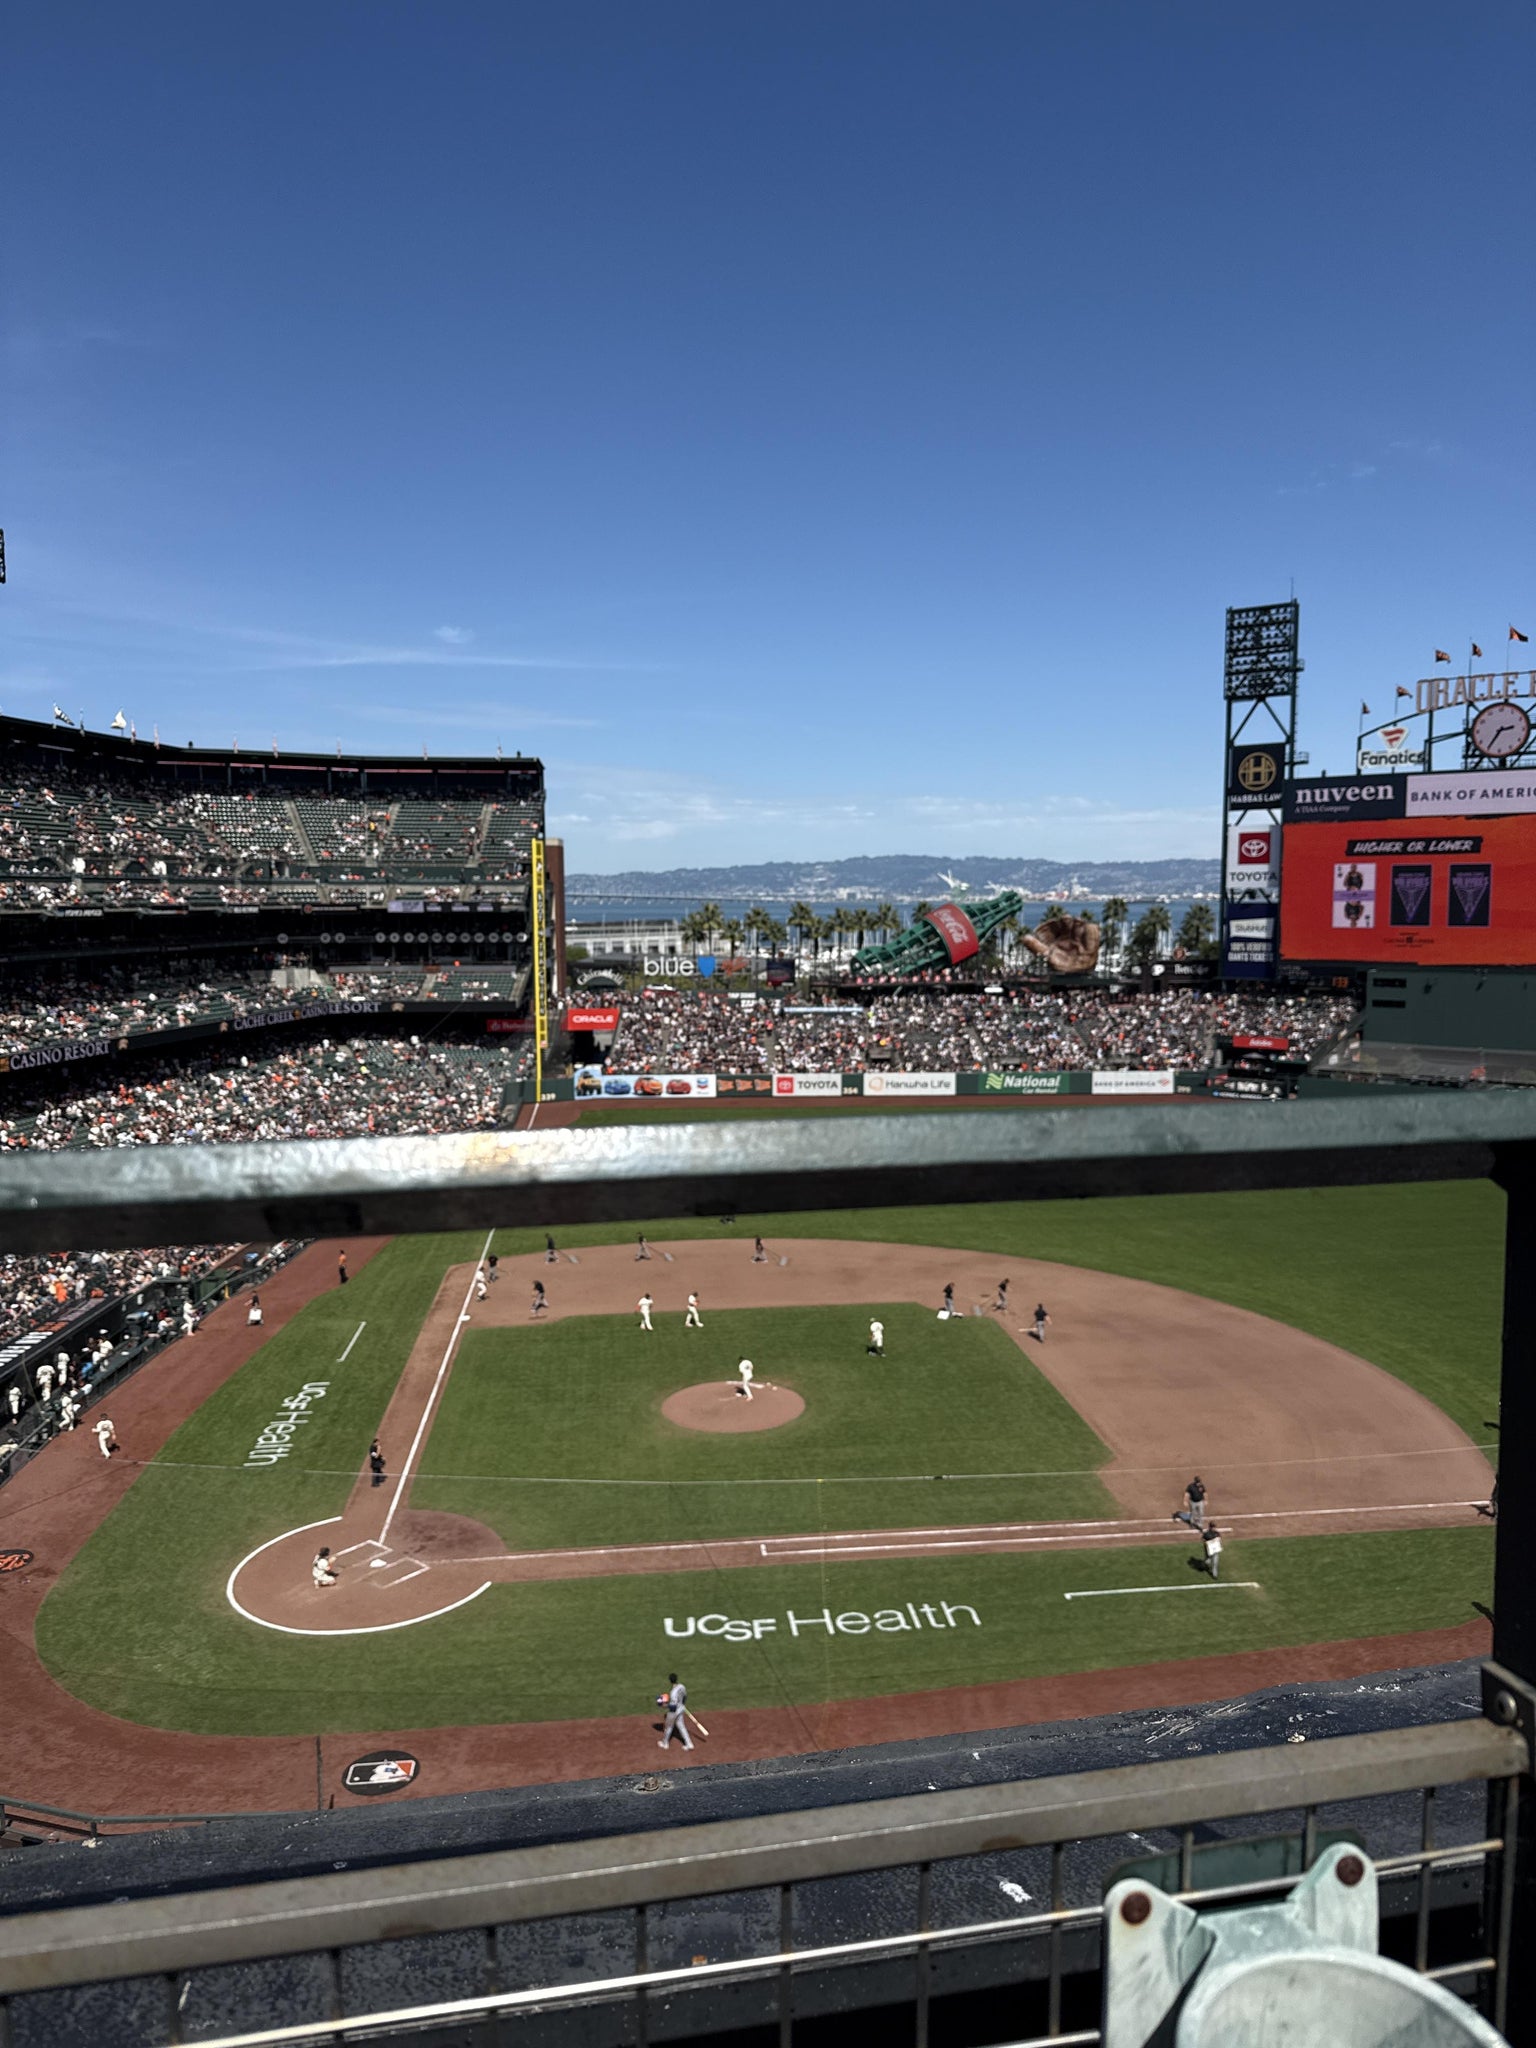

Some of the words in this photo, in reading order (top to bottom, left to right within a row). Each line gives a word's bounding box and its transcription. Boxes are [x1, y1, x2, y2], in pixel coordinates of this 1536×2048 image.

[1416, 672, 1519, 713] ORACLE
[1360, 749, 1426, 767] Fanatics
[1264, 792, 1282, 802] LAW
[1295, 784, 1394, 804] nuveen
[1410, 793, 1453, 802] BANK
[1456, 789, 1476, 800] OF
[1353, 842, 1403, 854] HIGHER
[1406, 841, 1425, 852] OR
[1428, 840, 1474, 852] LOWER
[1229, 871, 1277, 882] TOYOTA
[643, 956, 693, 976] blue
[234, 1015, 266, 1030] CACHE
[267, 1011, 294, 1025] CREEK
[572, 1015, 614, 1024] ORACLE
[10, 1049, 63, 1071] CASINO
[64, 1040, 111, 1061] RESORT
[797, 1080, 838, 1089] TOYOTA
[885, 1079, 927, 1089] Hanwha
[930, 1079, 950, 1089] Life
[1004, 1075, 1061, 1088] National
[541, 1093, 555, 1101] 339
[281, 1381, 331, 1410] UCSF
[243, 1411, 313, 1467] Health
[663, 1614, 777, 1641] UCSF
[786, 1601, 979, 1637] Health
